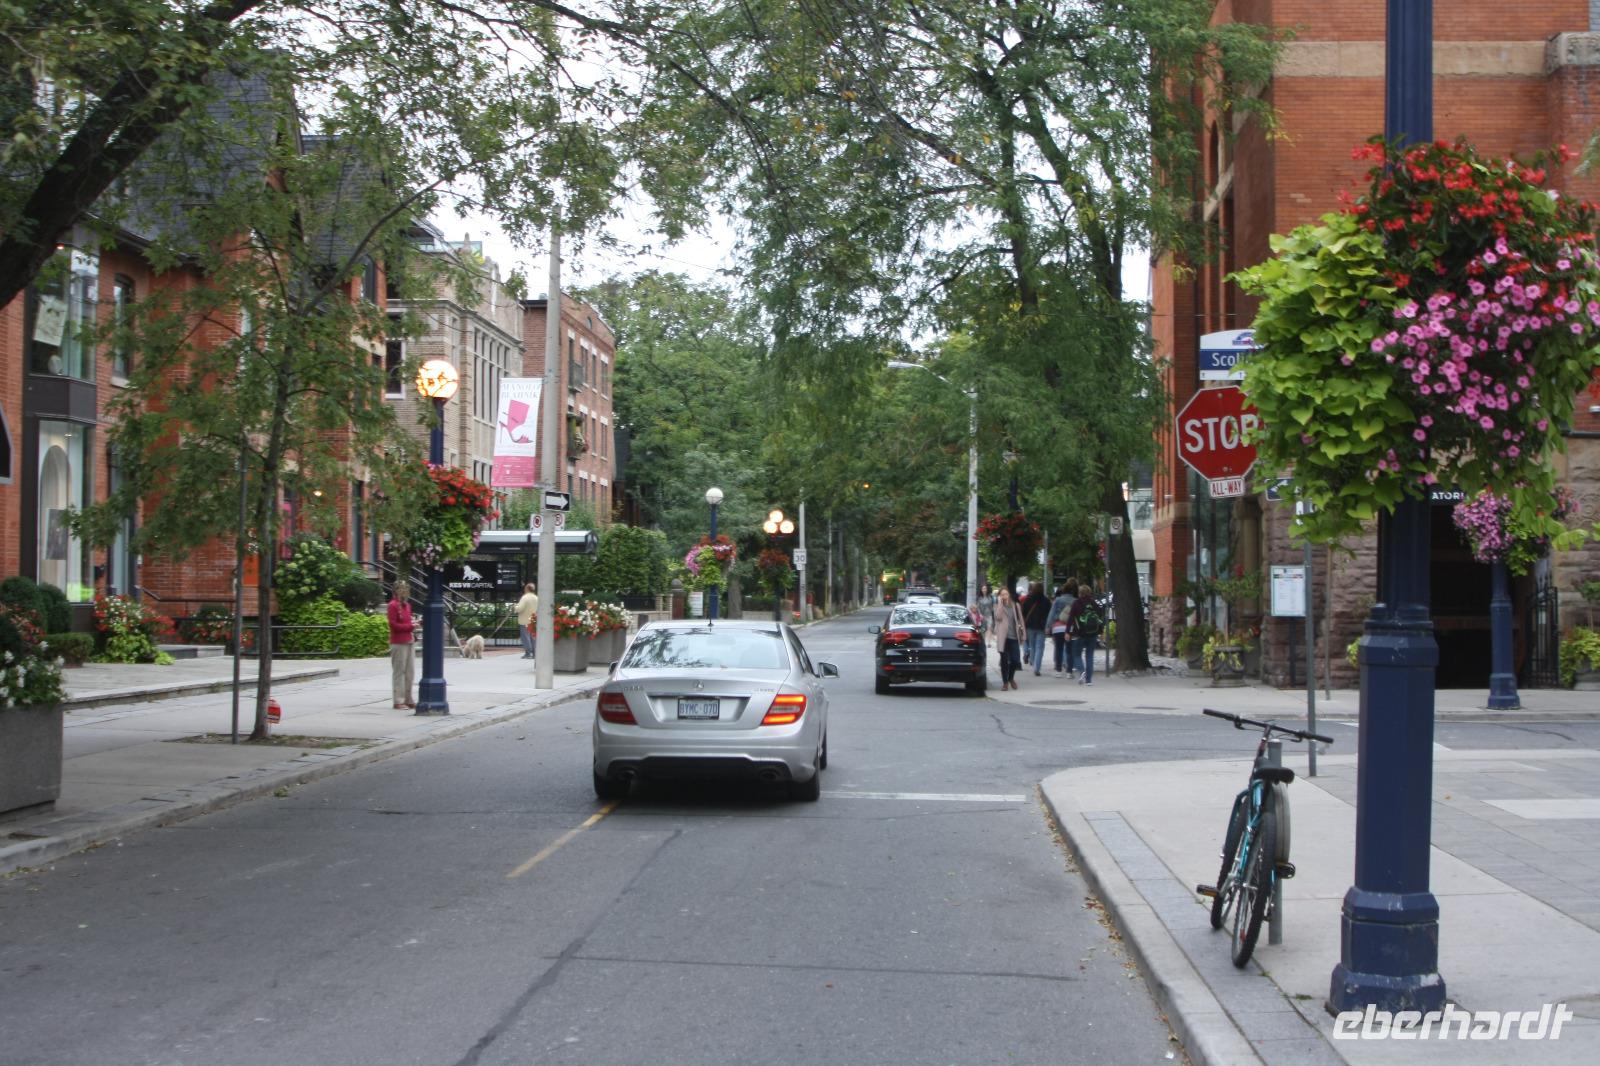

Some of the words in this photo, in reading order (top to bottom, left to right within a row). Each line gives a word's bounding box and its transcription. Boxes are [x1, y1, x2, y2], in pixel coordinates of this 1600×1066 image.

[1211, 352, 1244, 367] Scol
[1185, 413, 1259, 453] STOP
[1212, 480, 1243, 496] ALL-WAY
